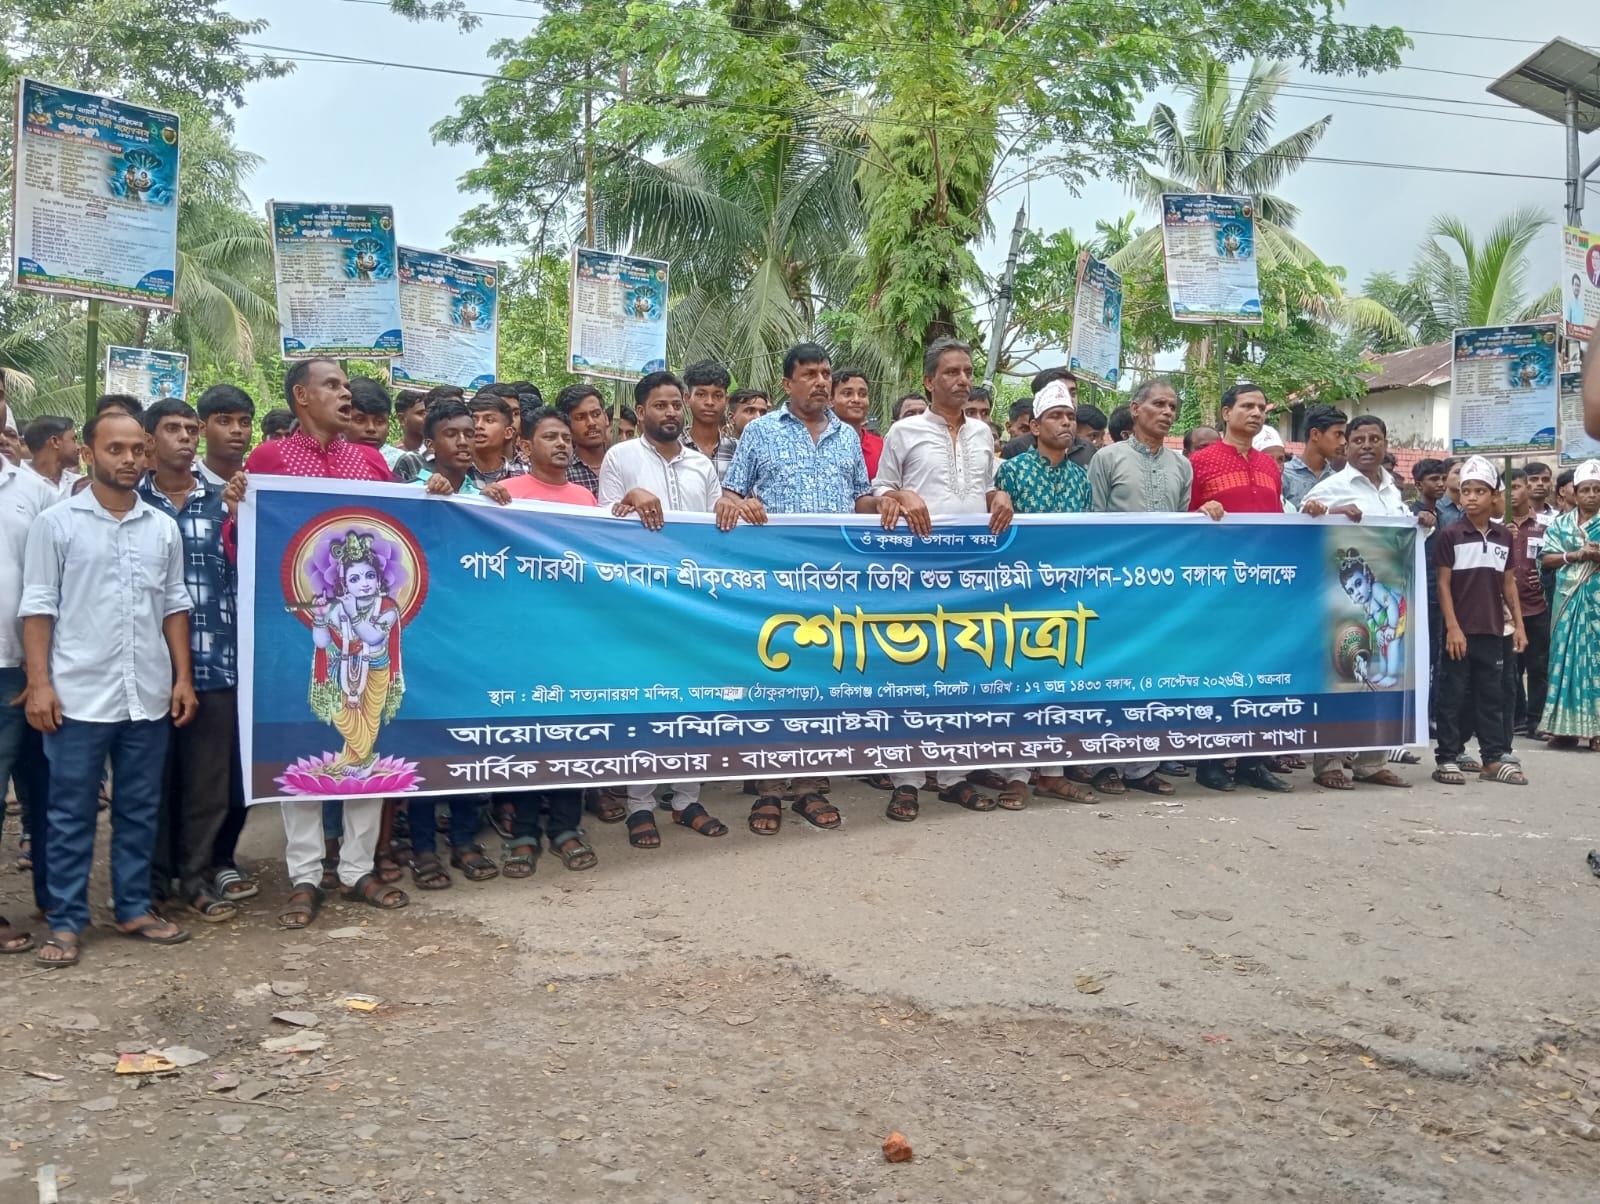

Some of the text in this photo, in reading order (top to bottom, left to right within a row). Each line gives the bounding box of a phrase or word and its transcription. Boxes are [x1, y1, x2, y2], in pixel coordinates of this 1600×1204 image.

[460, 547, 510, 579] পার্থ
[516, 549, 588, 582] সারথী
[593, 560, 671, 587] ভগবান
[675, 559, 767, 598] শ্রীকৃষ্ণের
[773, 562, 861, 592] আবির্ভাব
[866, 563, 914, 591] তিথি
[920, 570, 953, 588] শুভ
[1181, 565, 1228, 585] বঙ্গাব্দ
[1232, 560, 1297, 584] উপলক্ষে
[757, 601, 1099, 672] শোভাযাত্রা
[488, 689, 515, 707] স্থান
[532, 685, 564, 702] শ্রীশ্রী
[643, 684, 683, 700] মন্দির,
[746, 683, 823, 701] (ঠাকুরপাড়া),
[829, 683, 872, 697] জকিগঞ্জ
[878, 682, 929, 698] পৌরসভা,
[934, 681, 969, 695] সিলেট
[981, 680, 1012, 693] তারিখ
[1025, 682, 1040, 692] ১৭
[1044, 680, 1065, 692] ভাদ্র
[1071, 680, 1101, 691] ১৪৩৩
[1203, 672, 1253, 687] ২০২৬খ্রি.)
[1257, 674, 1291, 684] শুক্রবার
[448, 723, 614, 744] আয়োজনে
[650, 714, 774, 738] সম্মিলিত
[781, 710, 893, 735] জন্মাষ্টমী
[1024, 706, 1112, 726] পরিষদ,
[1122, 702, 1222, 722] জকিগঞ্জ,
[1231, 698, 1304, 718] সিলেট
[447, 755, 539, 781] সার্বিক
[546, 750, 711, 777] সহযোগিতায়
[739, 746, 854, 768] বাংলাদেশ
[864, 744, 913, 769] পূজা
[1020, 736, 1072, 758] ফ্রন্ট,
[1080, 733, 1160, 753] জকিগঞ্জ
[1167, 731, 1255, 748] উপজেলা
[1260, 729, 1306, 745] শাখা
